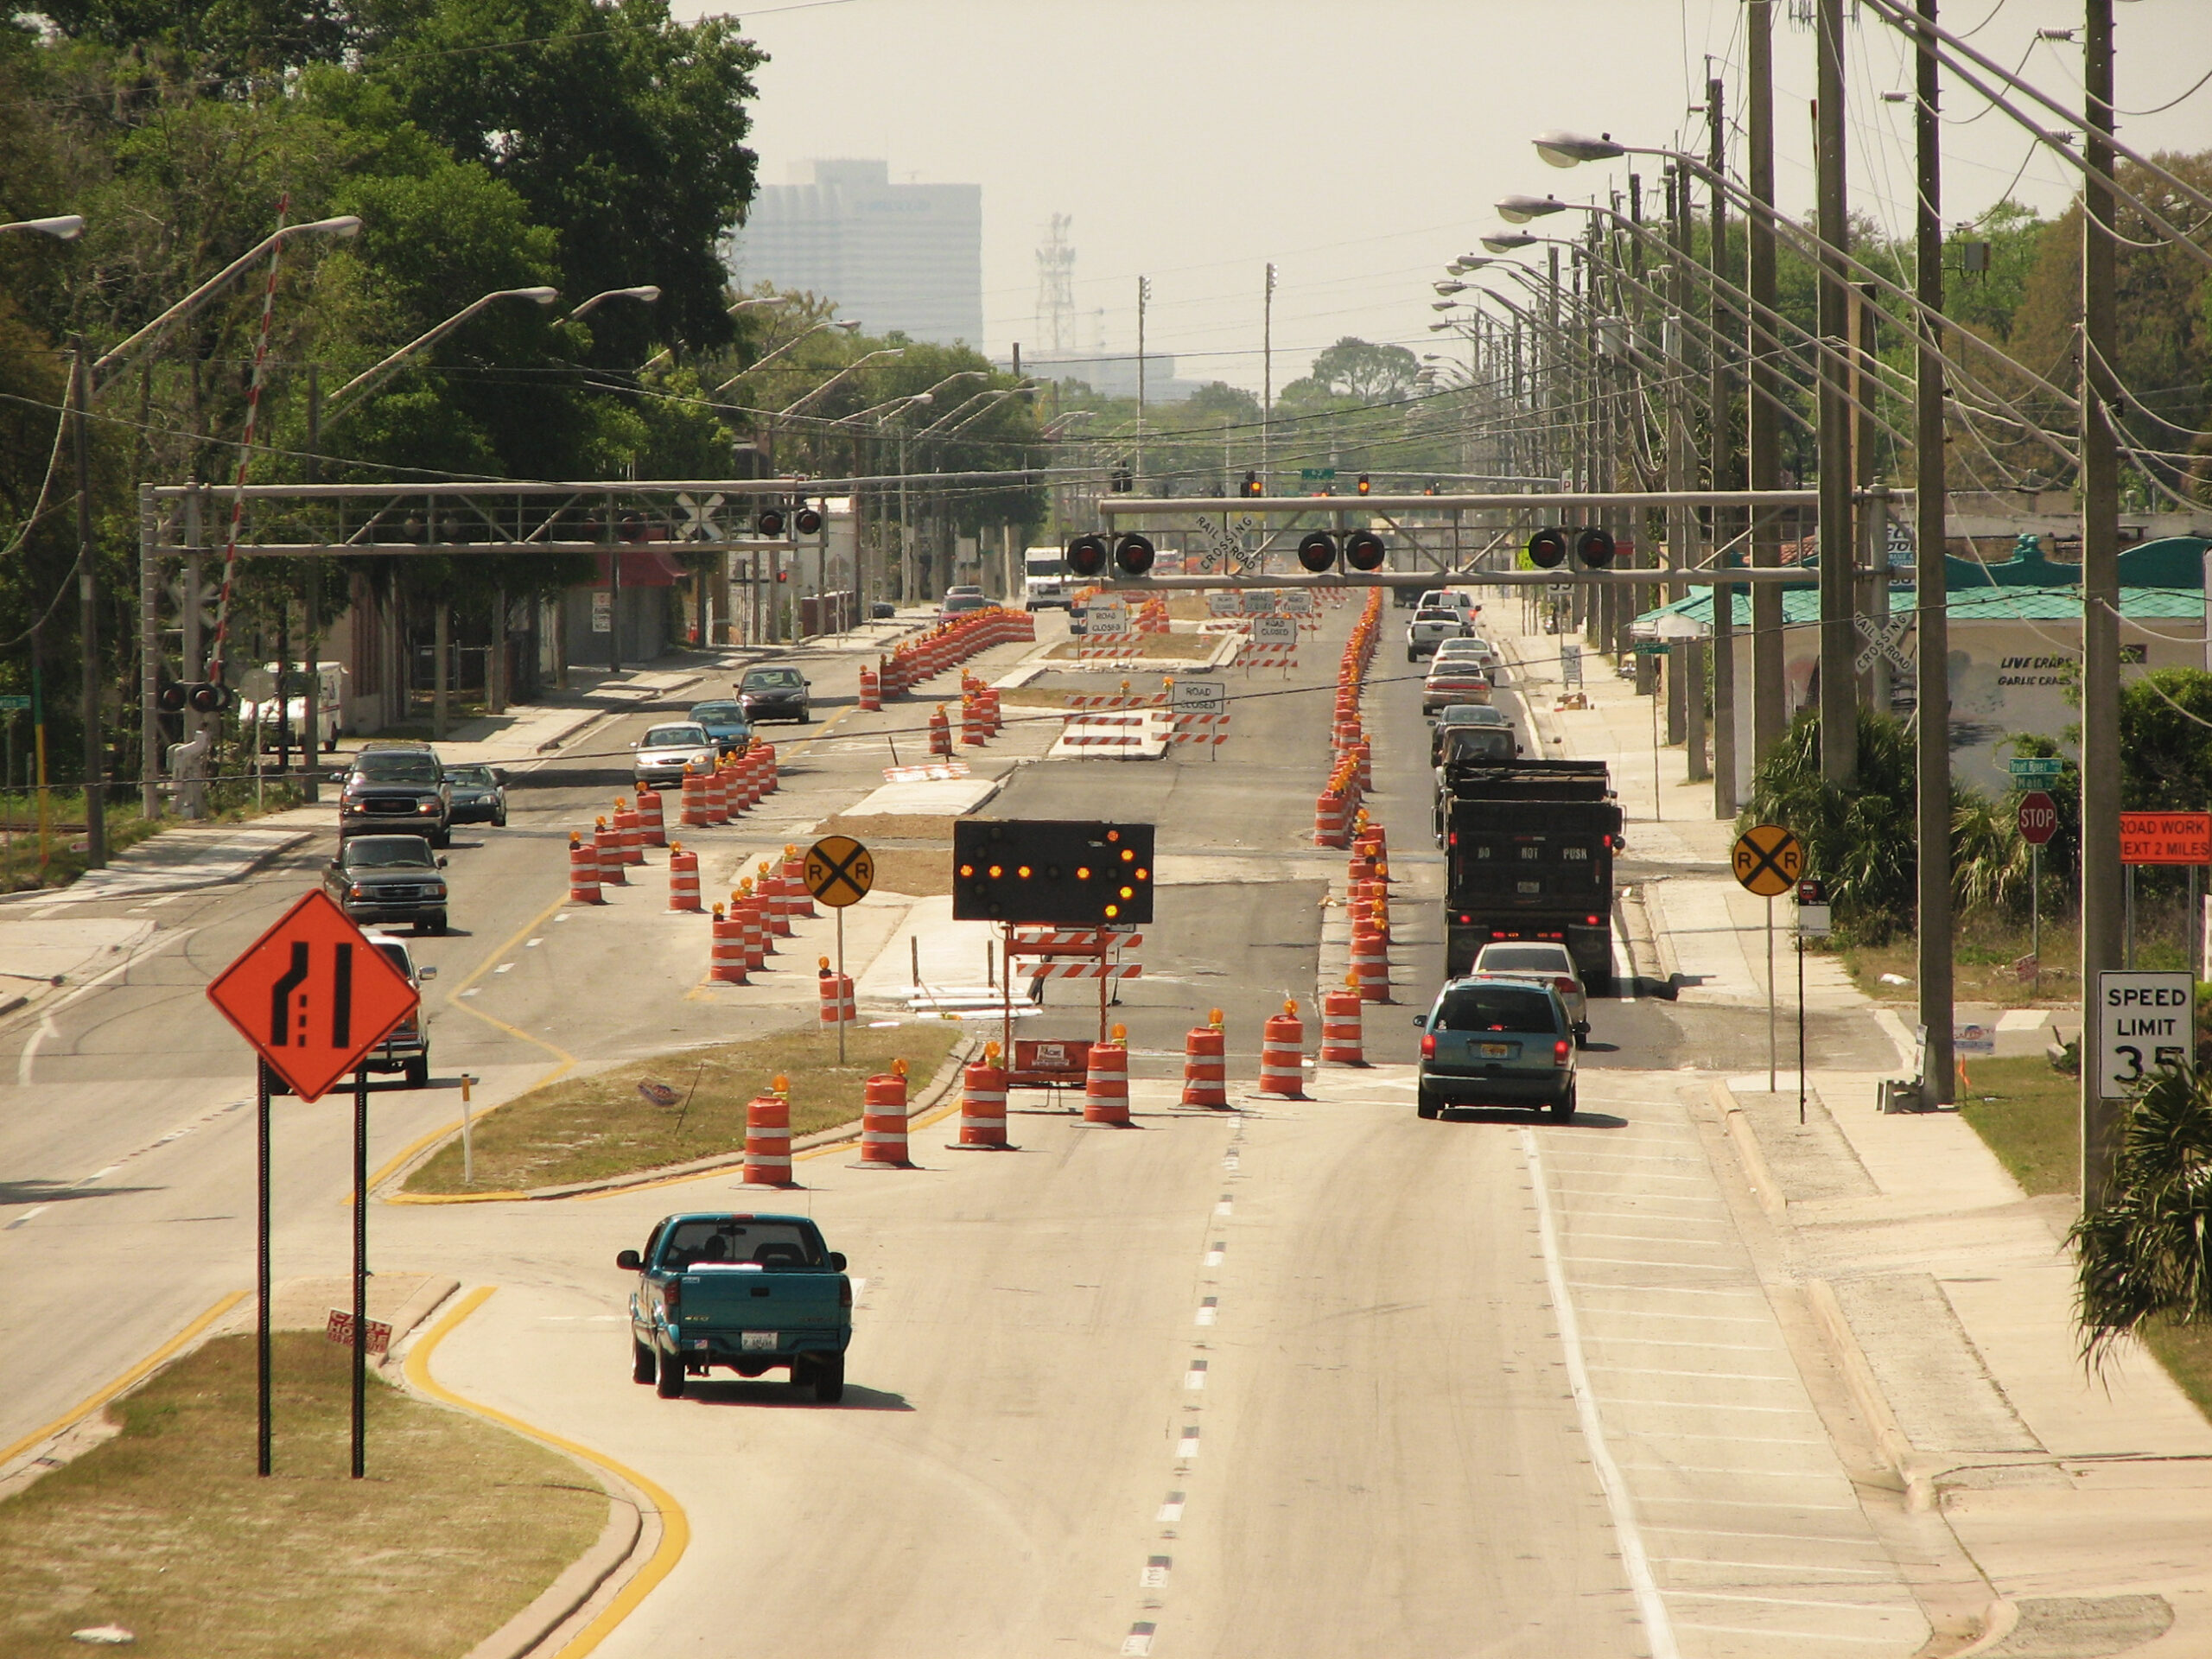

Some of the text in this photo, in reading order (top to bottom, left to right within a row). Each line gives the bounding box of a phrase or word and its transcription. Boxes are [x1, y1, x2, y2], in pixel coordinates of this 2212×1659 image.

[1196, 517, 1255, 569] RAIL ROAD
[1200, 517, 1252, 569] CROSSING
[1855, 614, 1910, 670] RAIL ROAD
[1857, 615, 1906, 669] CROSSING
[2000, 658, 2032, 669] LIVE
[1998, 677, 2037, 685] GARLIC
[1185, 687, 1211, 696] ROAD
[1181, 699, 1216, 709] CLOSED
[2018, 776, 2044, 788] Main
[2022, 809, 2054, 828] STOP
[2161, 820, 2205, 834] WORK
[1478, 847, 1587, 860] DO NOT PUSH
[2121, 842, 2209, 855] EXT 2 MILES
[1738, 851, 1798, 869] R R
[809, 862, 868, 880] R R
[2108, 988, 2186, 1007] SPEED
[2117, 1019, 2177, 1036] LIMIT
[327, 1321, 389, 1346] HOSE
